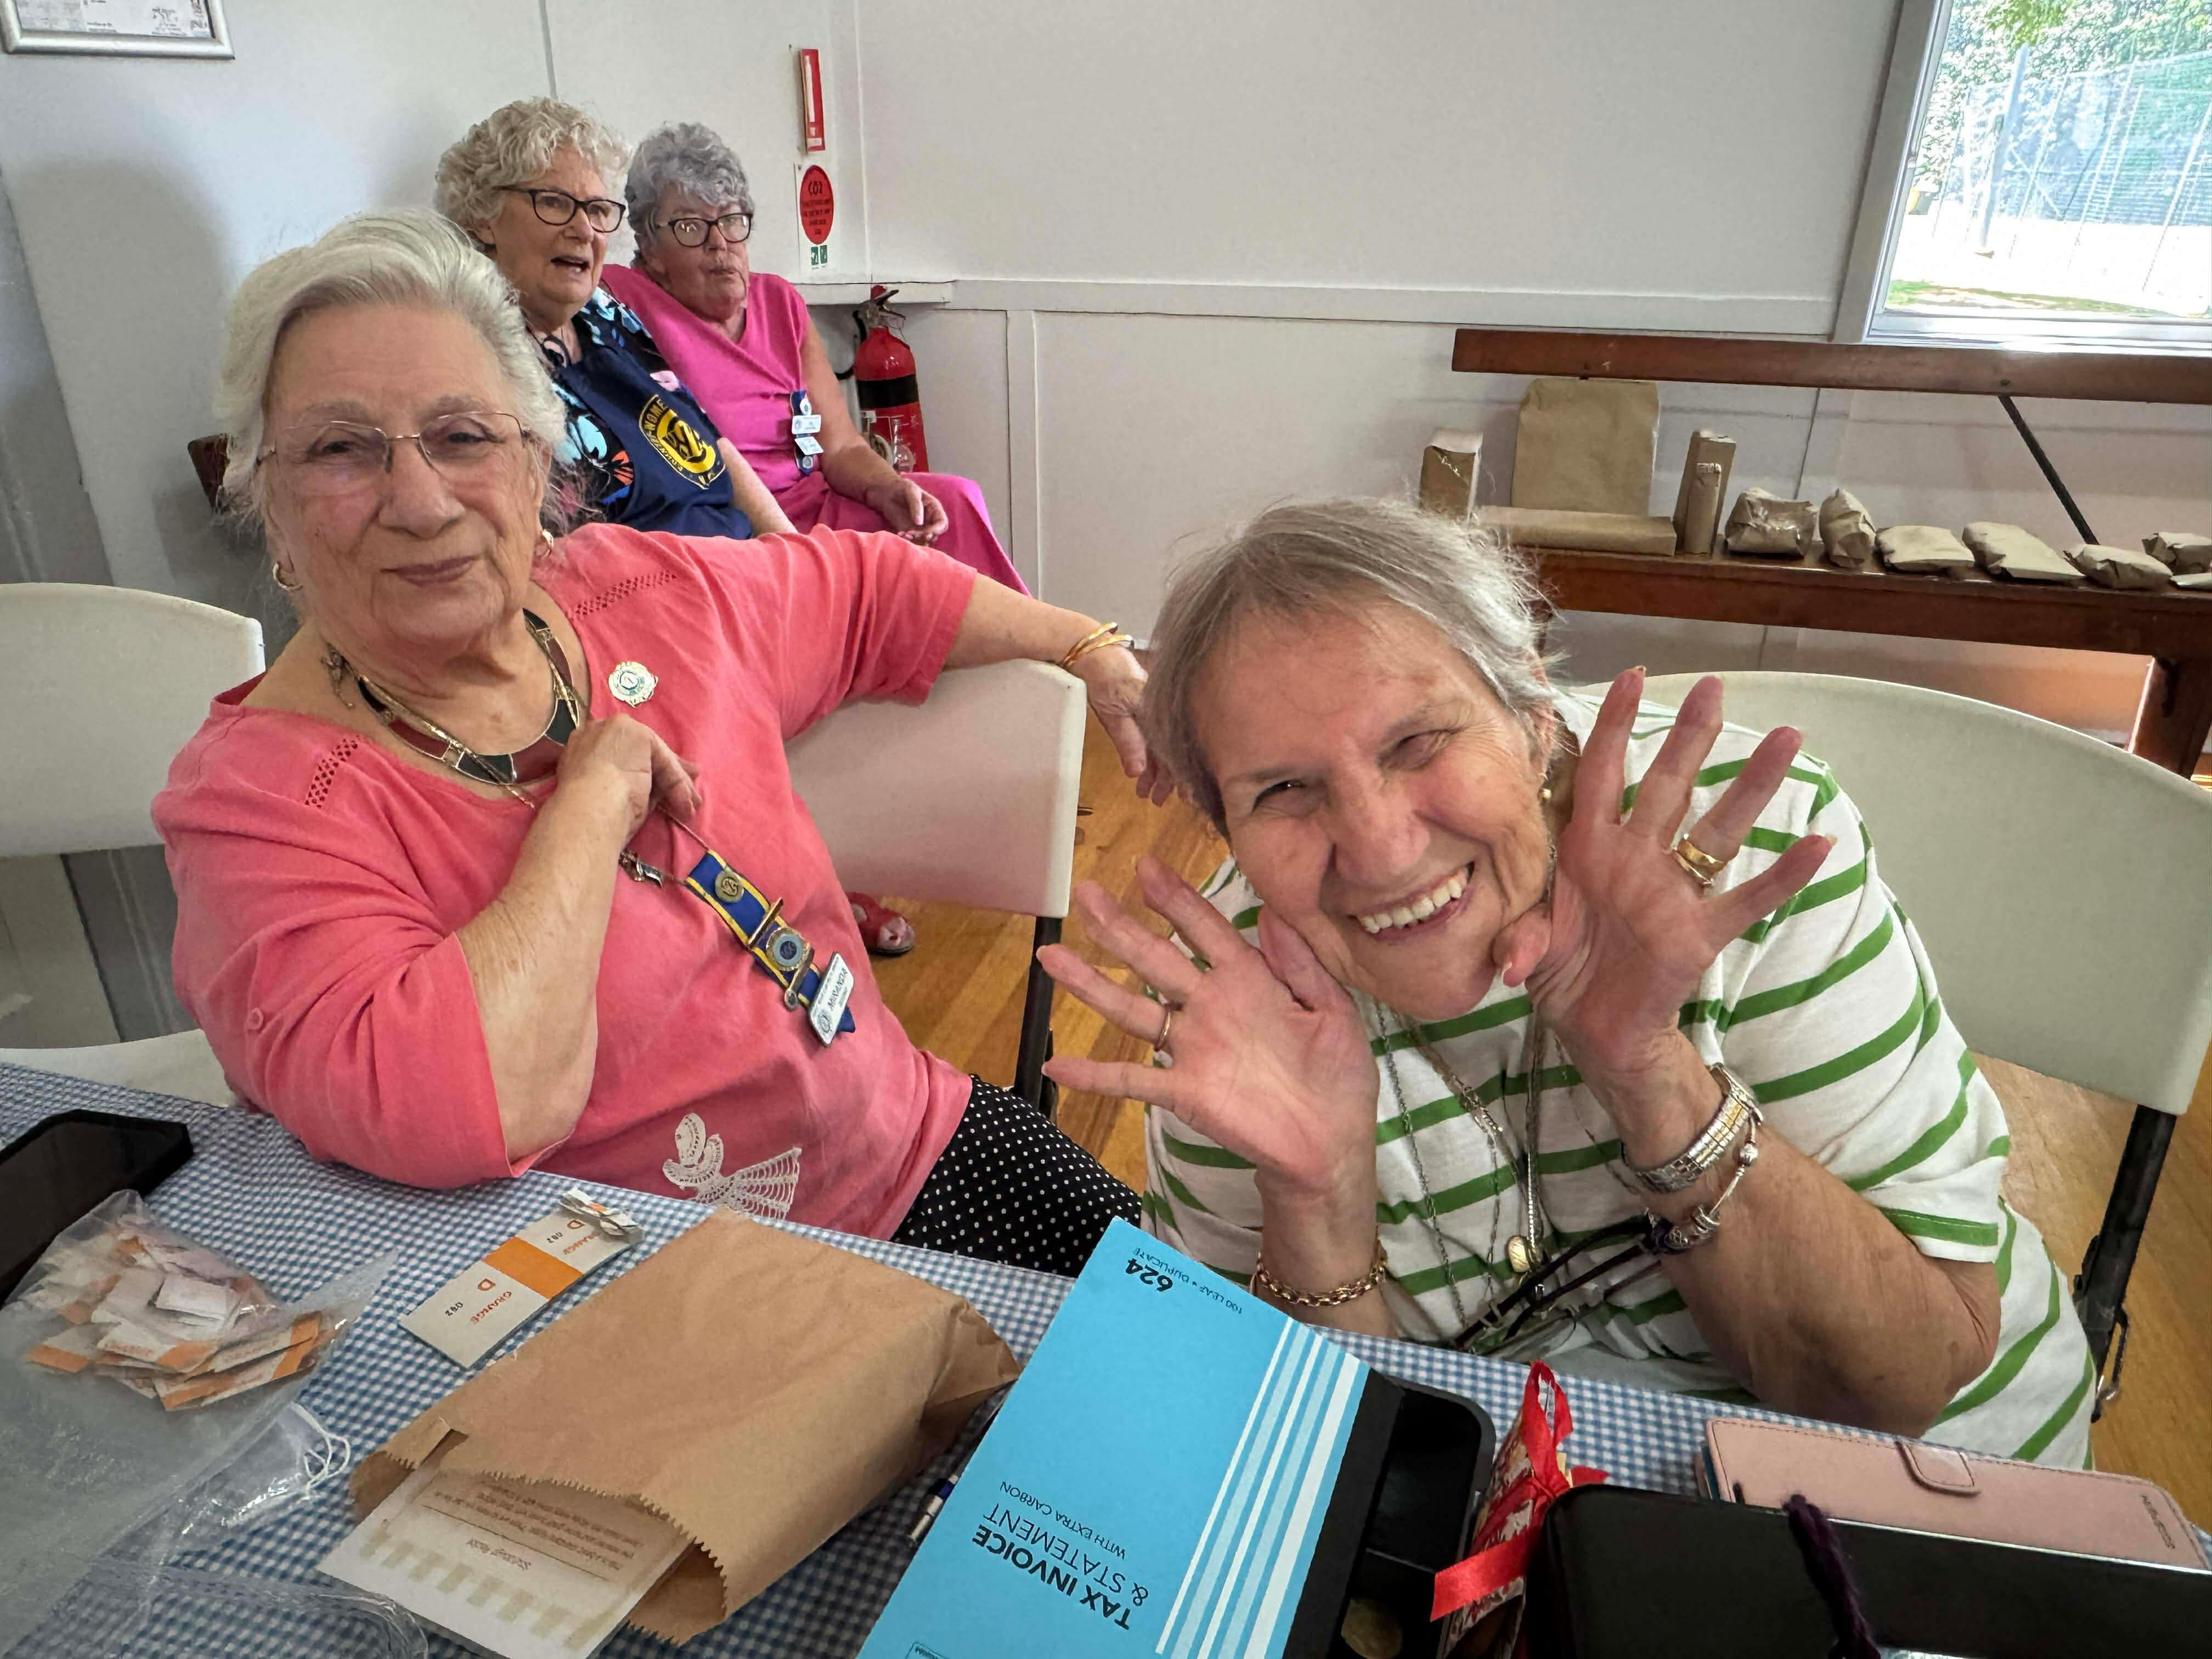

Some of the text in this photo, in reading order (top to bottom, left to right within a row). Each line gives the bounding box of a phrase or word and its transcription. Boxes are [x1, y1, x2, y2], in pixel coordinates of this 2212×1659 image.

[1125, 1258, 1173, 1292] 624
[1133, 1247, 1190, 1284] DUPLICATE
[477, 1278, 496, 1291] D
[1225, 1299, 1242, 1314] 100
[1000, 1481, 1126, 1560] WITH EXTRA CARBON
[983, 1503, 1149, 1607] & STATEMENT
[972, 1523, 1131, 1630] TAX INVOICE
